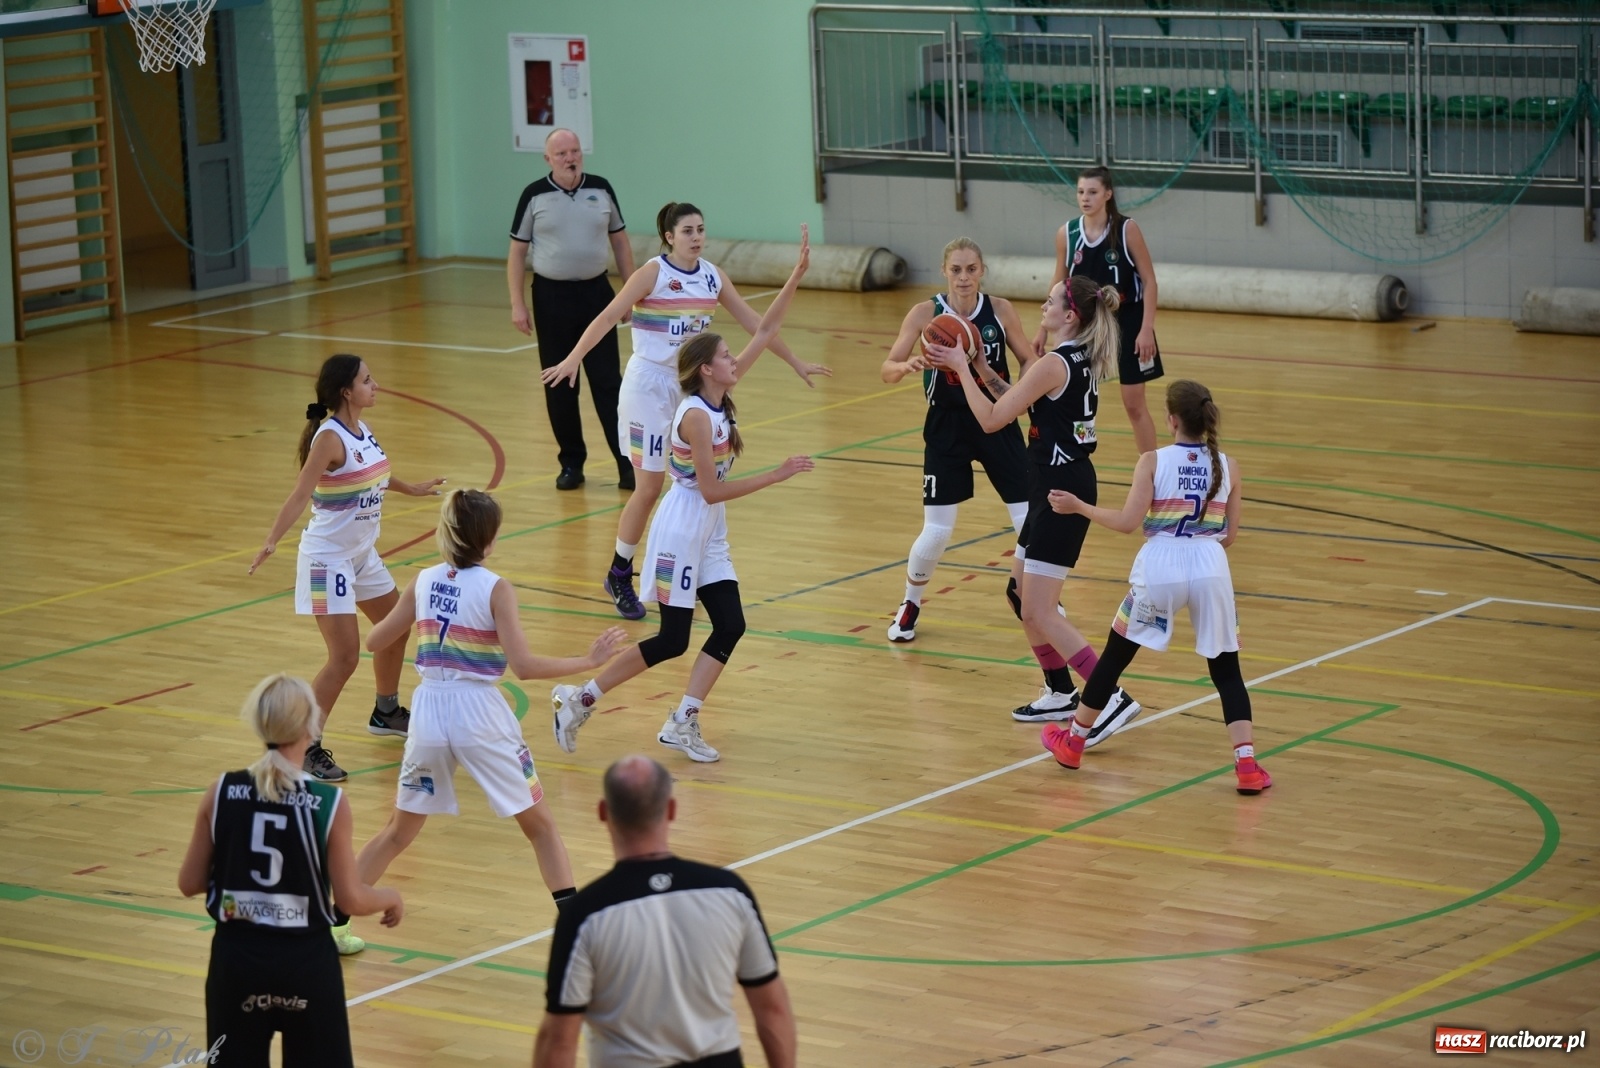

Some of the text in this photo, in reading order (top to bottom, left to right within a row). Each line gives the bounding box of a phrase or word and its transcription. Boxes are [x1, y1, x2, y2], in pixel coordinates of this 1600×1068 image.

[1108, 264, 1119, 285] 7
[649, 434, 663, 457] 14
[1177, 465, 1208, 477] KAMIENICA
[1178, 477, 1208, 491] POLSKA
[1174, 494, 1201, 538] 2
[335, 573, 347, 597] 8
[680, 565, 693, 591] 6
[430, 581, 462, 599] KAMIENICA
[429, 594, 459, 616] POLSKA
[436, 613, 451, 649] 7
[227, 784, 253, 800] RKK
[250, 811, 288, 888] 5
[238, 905, 305, 920] WAGTECH
[257, 993, 309, 1010] Clavis
